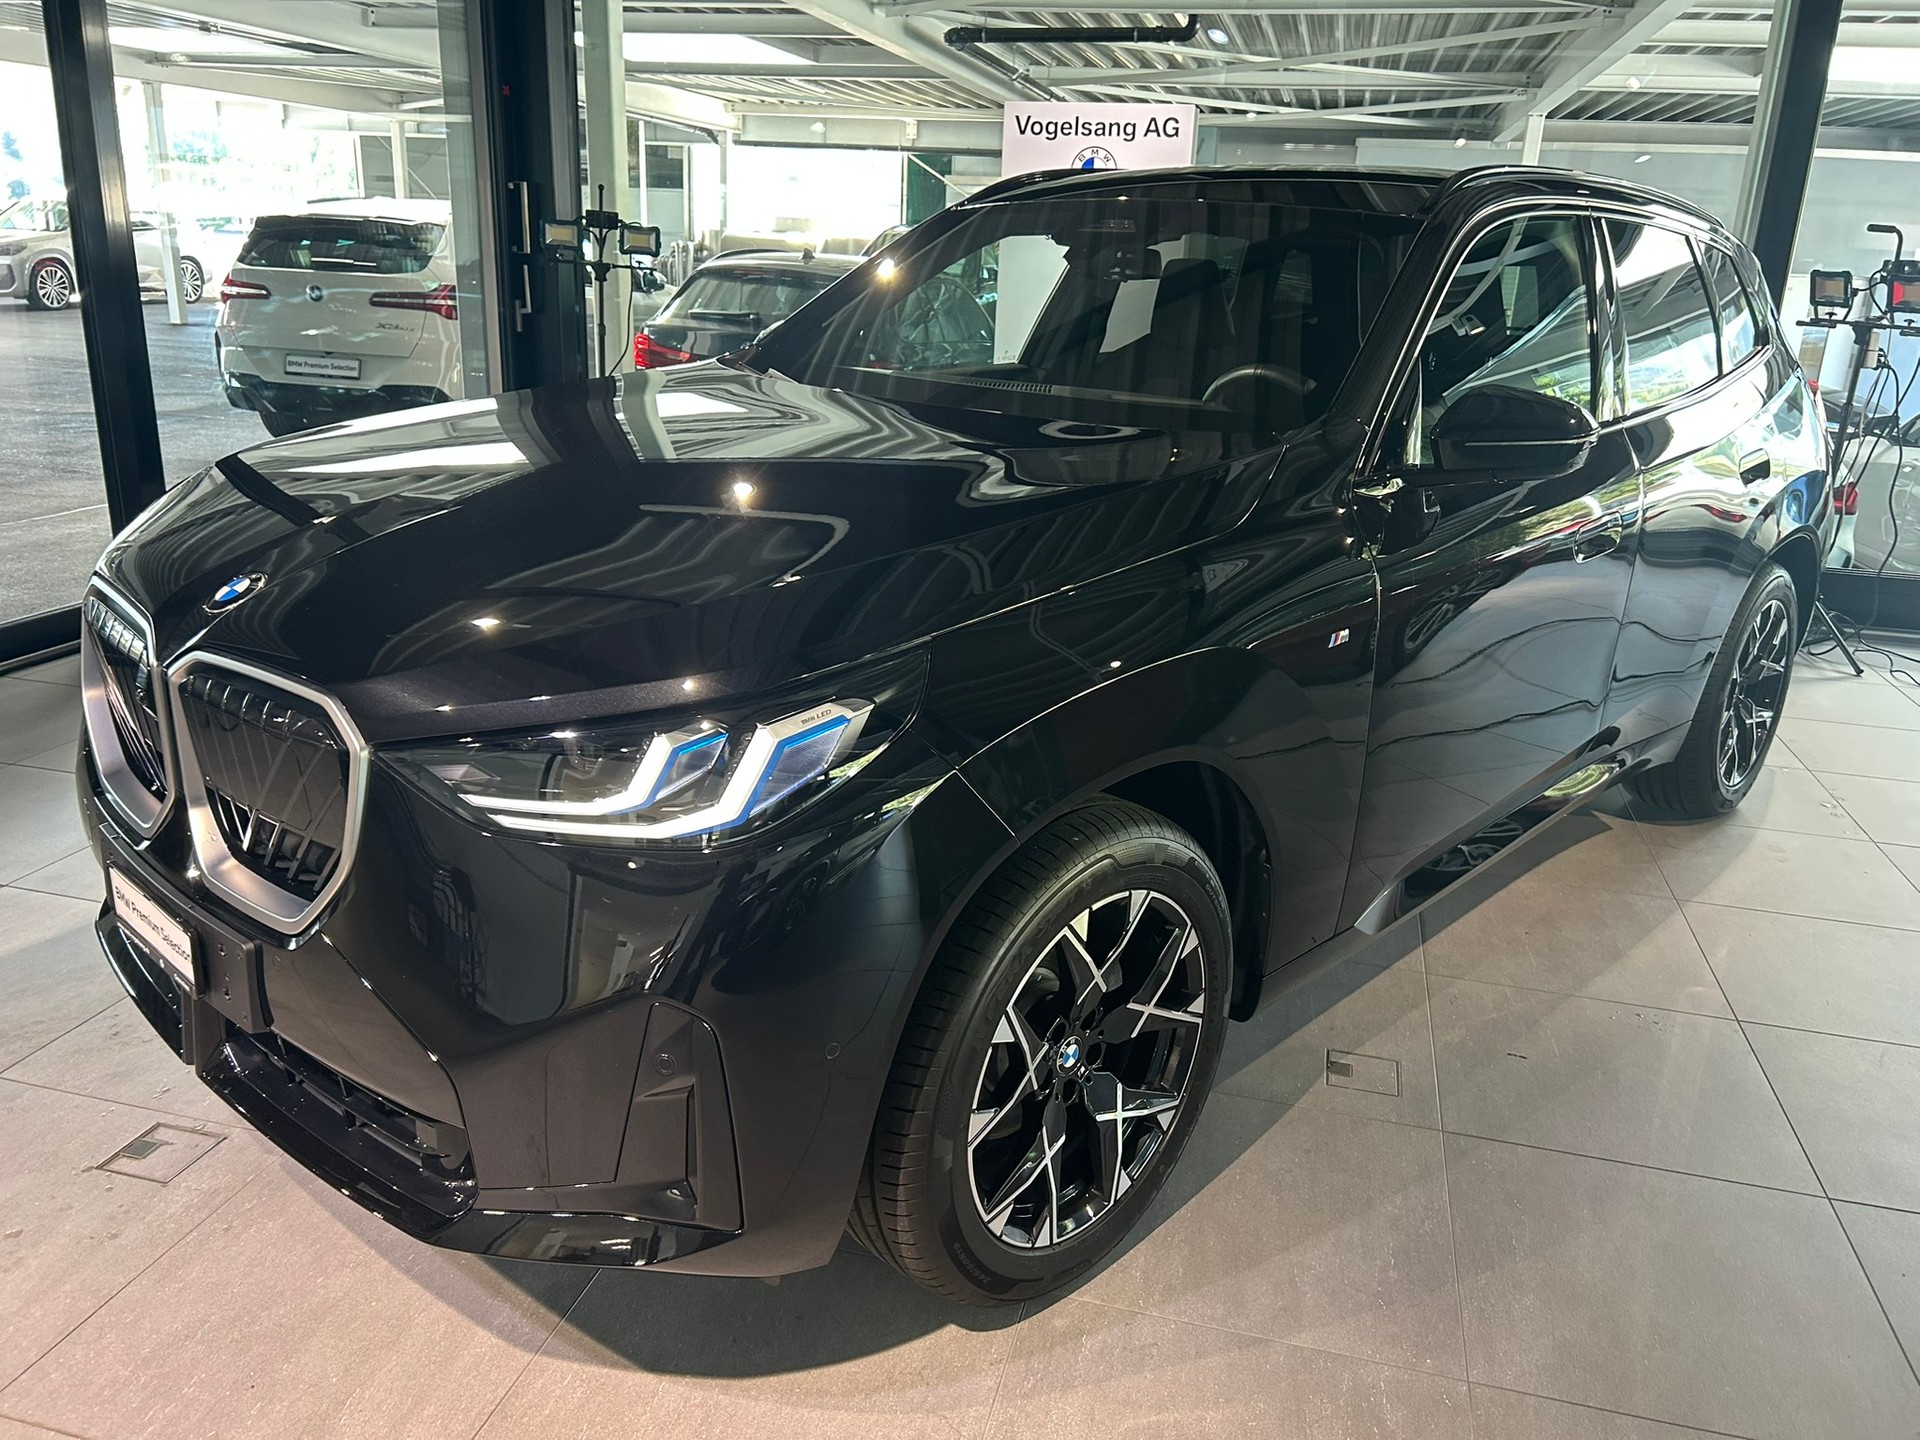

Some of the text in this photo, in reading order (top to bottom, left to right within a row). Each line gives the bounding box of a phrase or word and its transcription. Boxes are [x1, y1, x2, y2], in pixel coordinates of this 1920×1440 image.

[1015, 115, 1180, 142] Vogelsang AG
[303, 361, 330, 370] Premium
[330, 363, 357, 372] Selection
[801, 709, 832, 725] BMW LED
[114, 885, 131, 911] BMW
[131, 901, 161, 938] Premium
